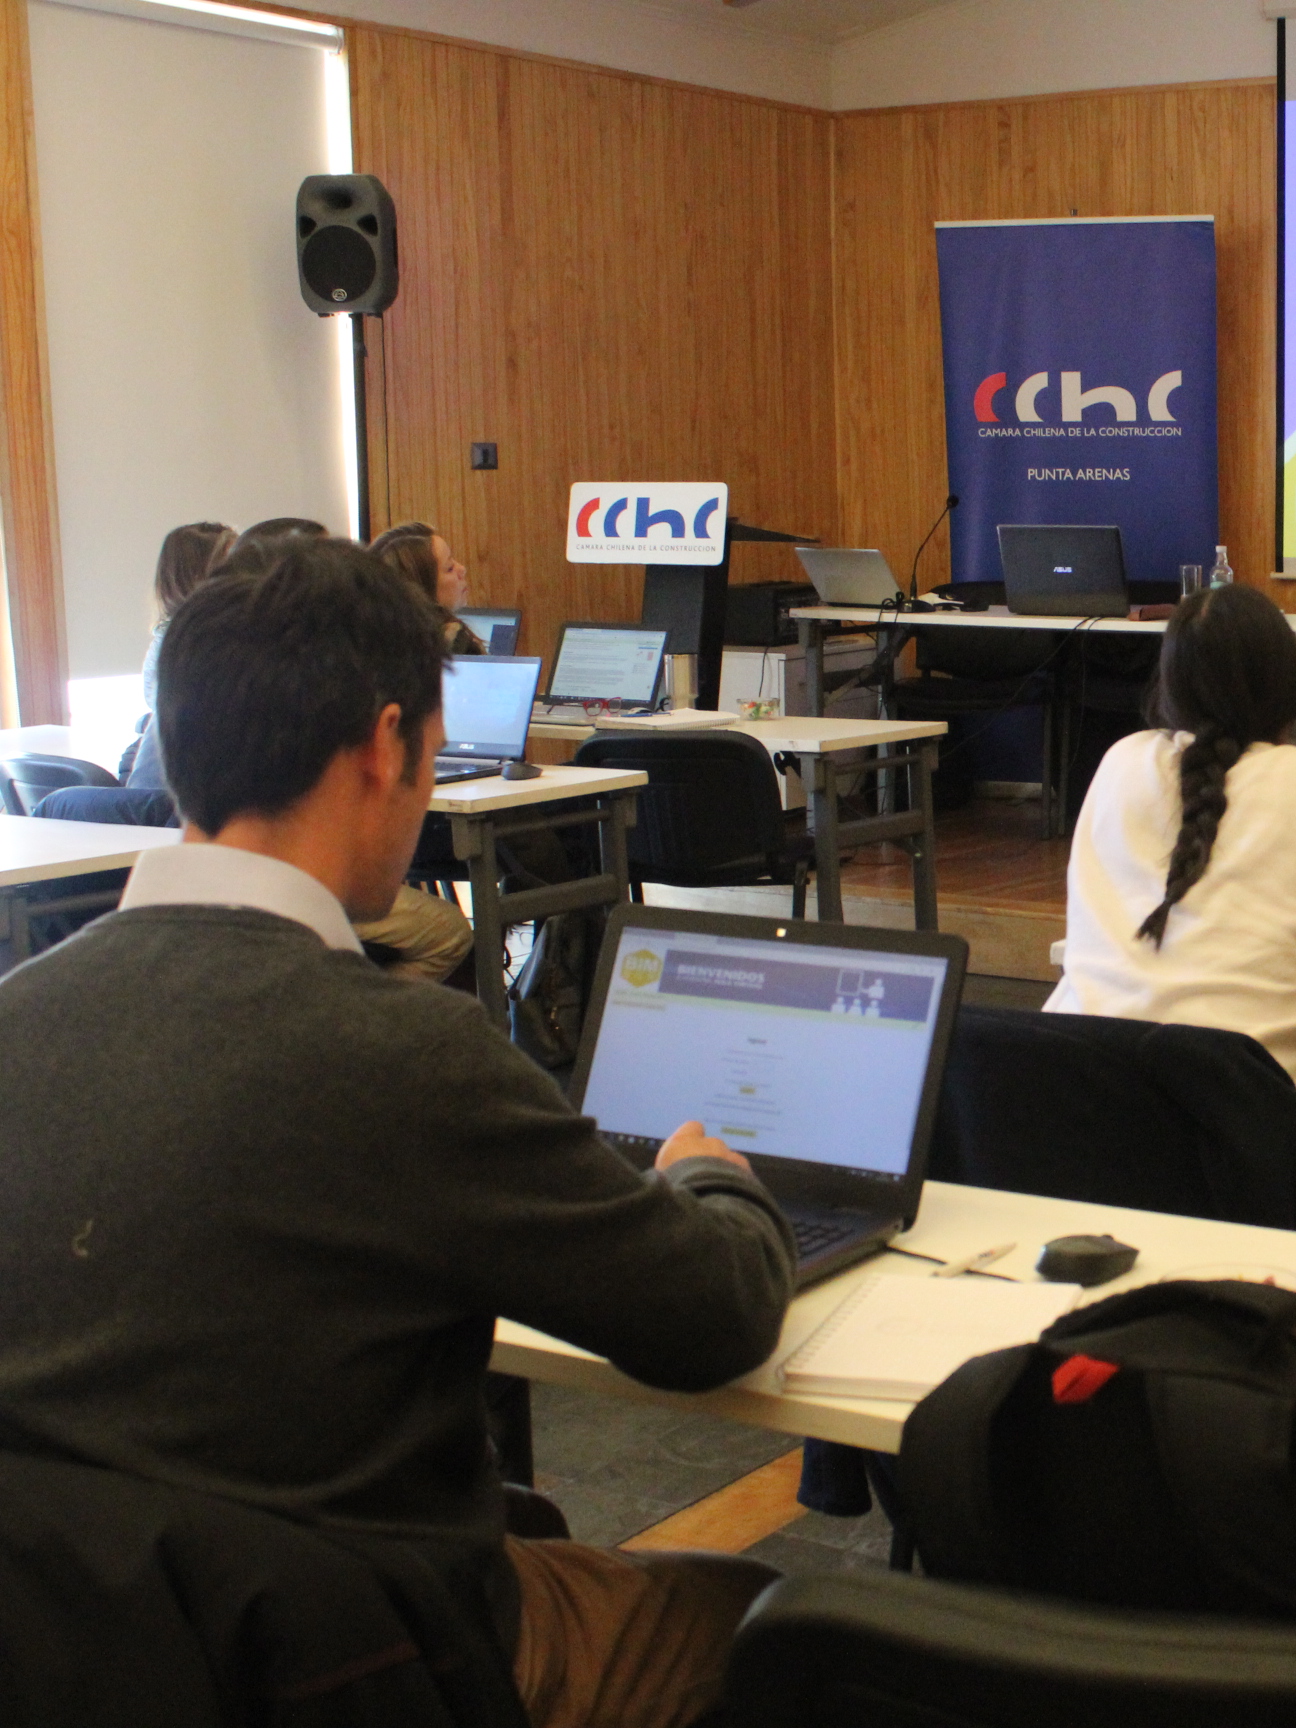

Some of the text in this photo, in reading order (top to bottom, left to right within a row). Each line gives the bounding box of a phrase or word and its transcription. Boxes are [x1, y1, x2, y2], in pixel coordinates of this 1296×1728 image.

[978, 427, 1182, 438] CAMARA CHILENA DE LA CONSTRUCCION
[1027, 468, 1131, 481] PUNTA ARENAS
[660, 544, 716, 552] CONSTRUCCION
